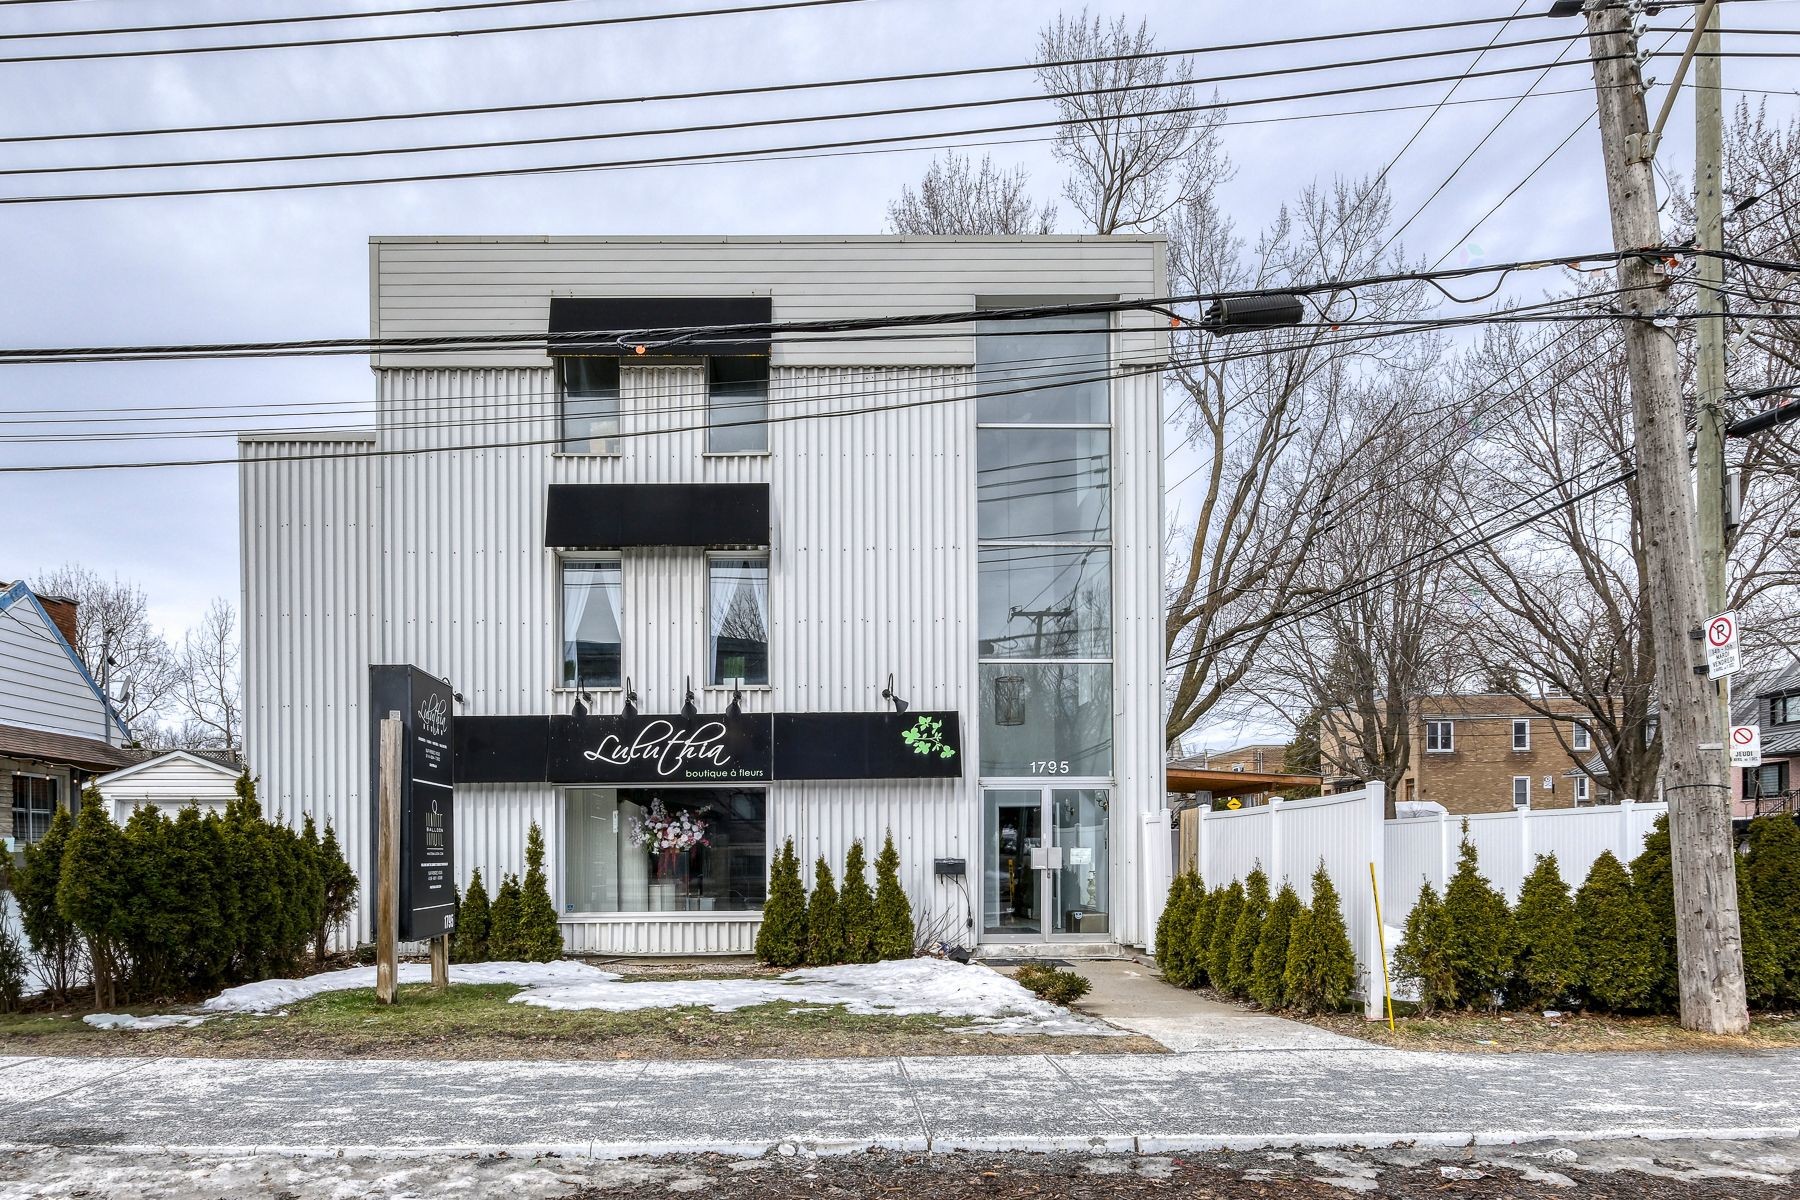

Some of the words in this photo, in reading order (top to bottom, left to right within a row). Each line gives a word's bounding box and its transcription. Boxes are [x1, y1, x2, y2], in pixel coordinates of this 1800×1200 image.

[1712, 655, 1735, 667] VENDREDI
[583, 719, 731, 776] Luluthia
[685, 769, 728, 779] boutique
[730, 769, 737, 777] à
[739, 768, 764, 777] fleurs
[1029, 760, 1070, 774] 1795
[443, 913, 454, 930] 1795
